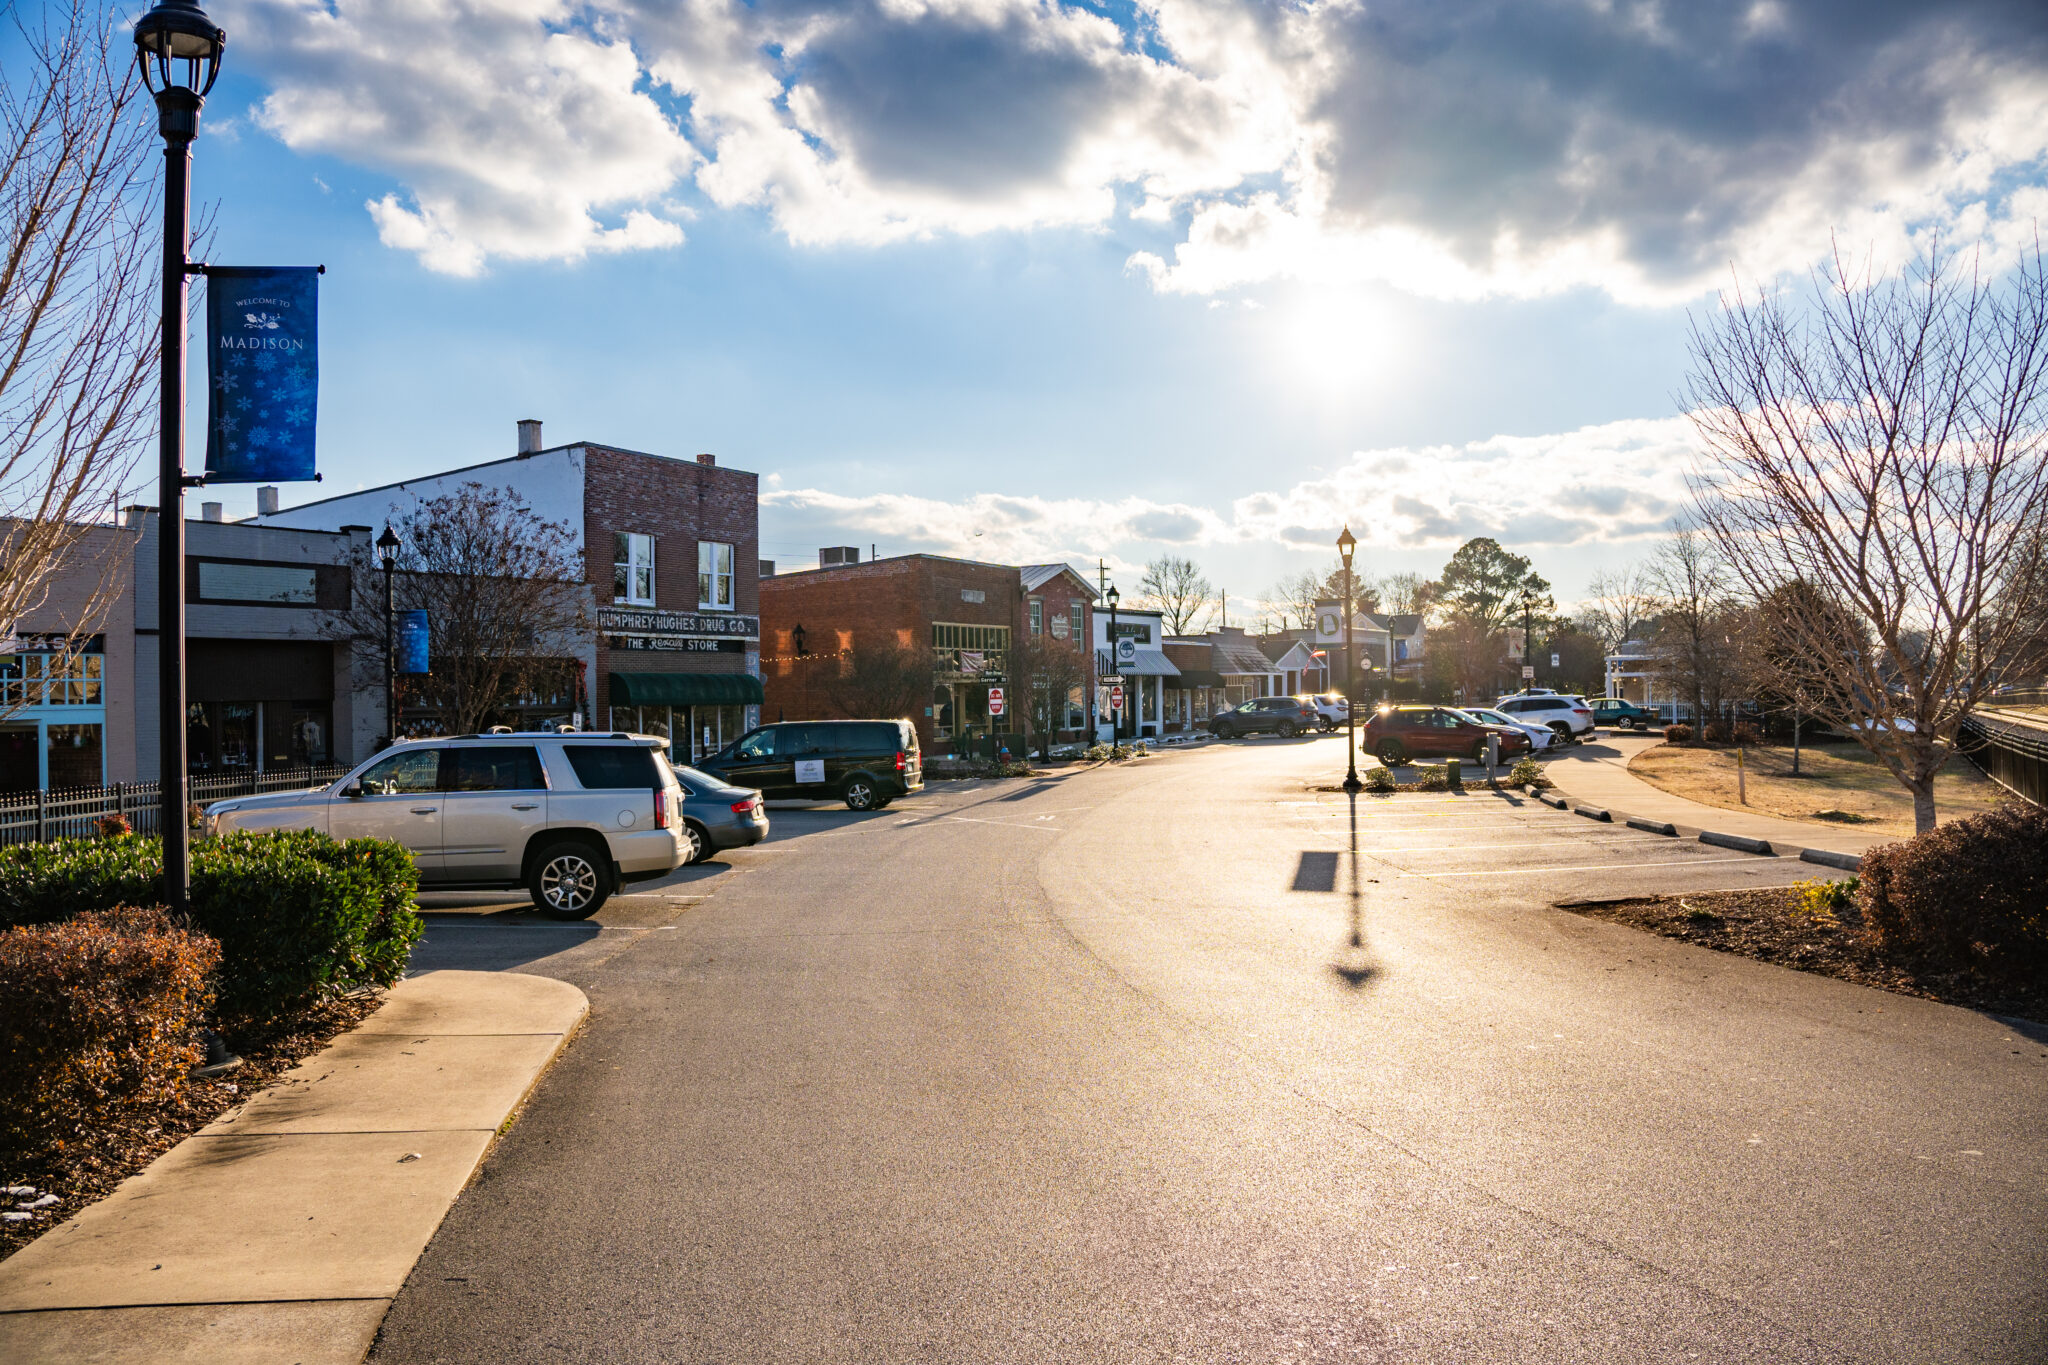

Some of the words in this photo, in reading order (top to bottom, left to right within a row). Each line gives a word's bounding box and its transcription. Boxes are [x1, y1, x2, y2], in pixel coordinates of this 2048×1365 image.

[235, 297, 277, 307] WELCOME
[279, 299, 291, 308] TO
[220, 335, 304, 350] MADISON
[700, 618, 726, 632] DRUG
[729, 620, 751, 633] CO.
[627, 638, 644, 649] THE
[687, 640, 719, 651] STORE
